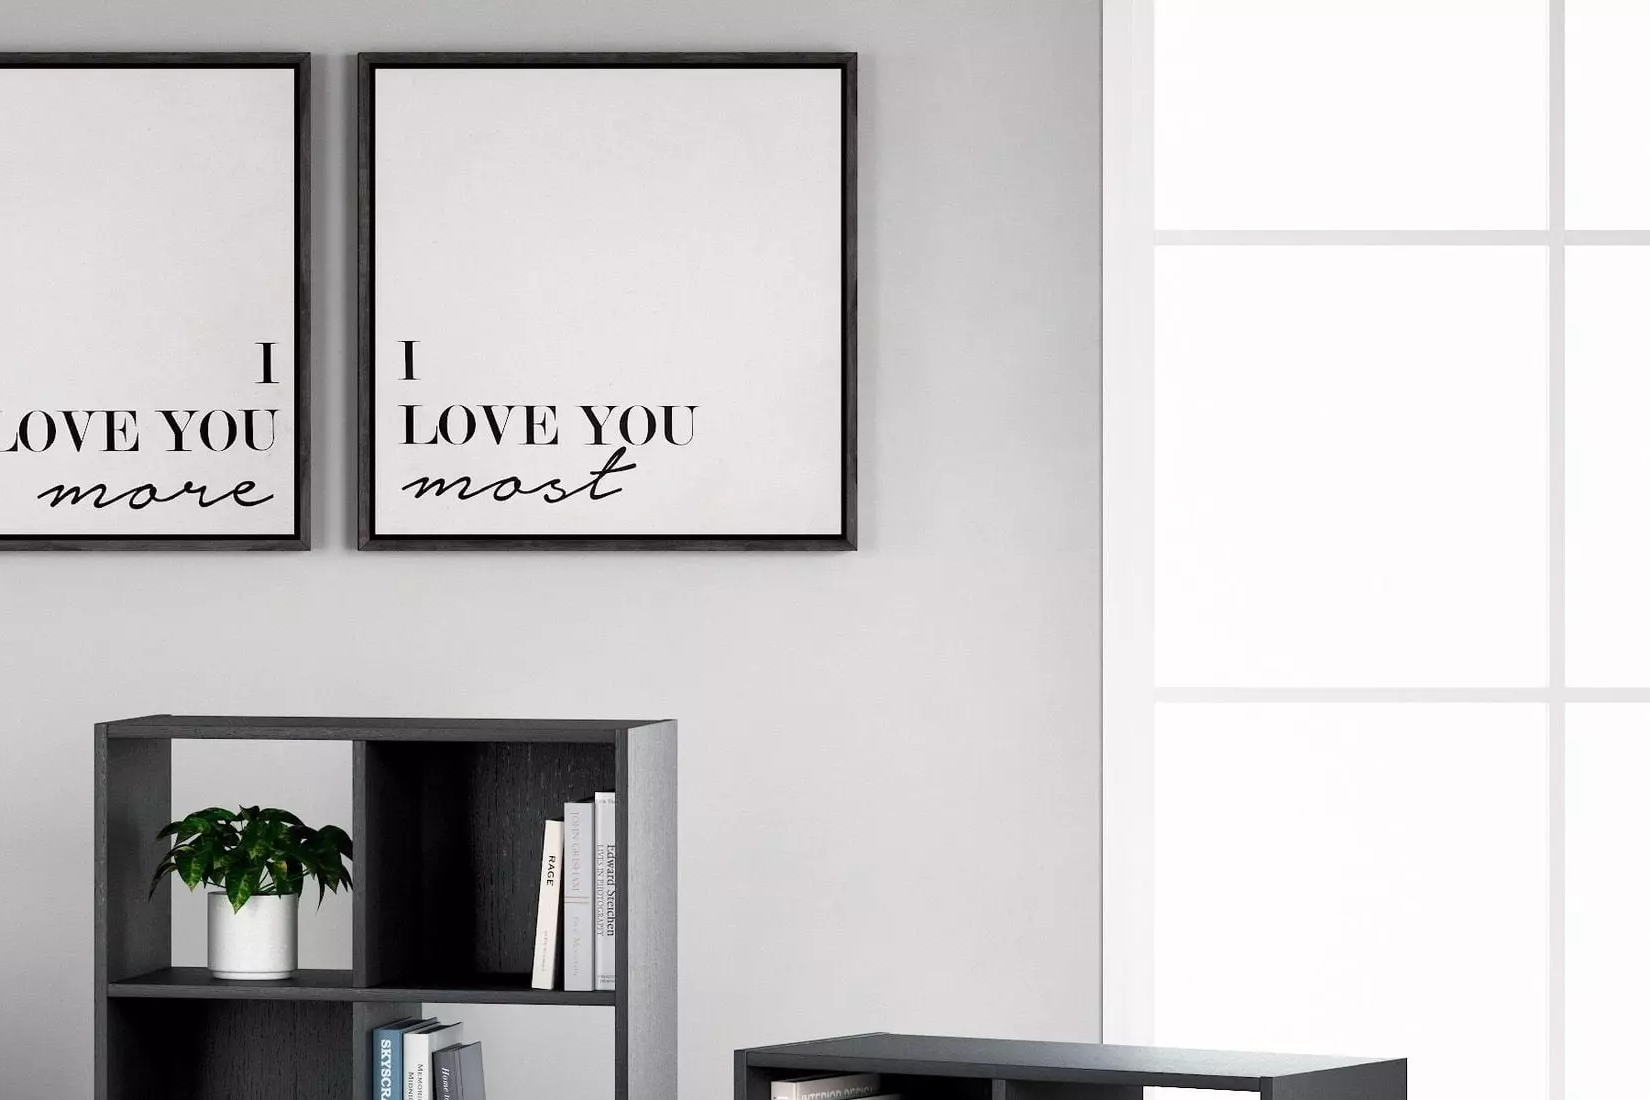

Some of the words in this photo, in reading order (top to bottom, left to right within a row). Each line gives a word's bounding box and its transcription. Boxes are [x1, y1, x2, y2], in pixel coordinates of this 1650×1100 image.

[255, 341, 280, 385] I
[397, 340, 422, 382] I
[156, 409, 281, 454] YOU
[397, 405, 559, 448] LOVE
[578, 405, 699, 448] YOU
[37, 473, 275, 511] more
[401, 446, 636, 506] most
[546, 855, 556, 887] RAGE
[607, 844, 615, 886] Edward
[607, 890, 615, 936] Steichen
[442, 1067, 450, 1092] Home
